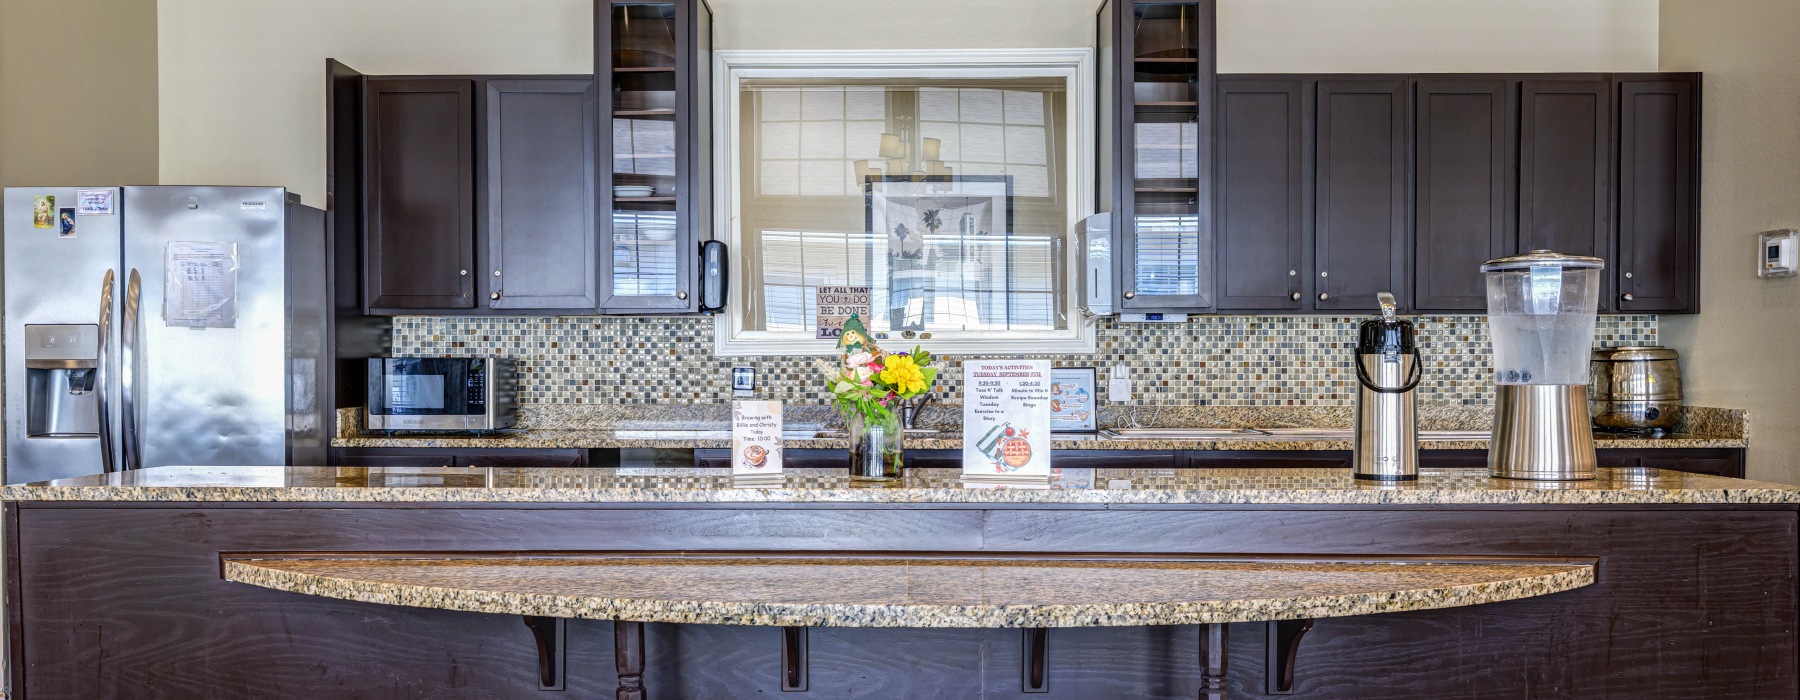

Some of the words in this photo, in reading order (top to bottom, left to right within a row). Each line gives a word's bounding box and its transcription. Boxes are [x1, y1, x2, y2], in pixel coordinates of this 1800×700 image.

[820, 295, 839, 303] YOU
[854, 295, 867, 303] DO
[820, 306, 834, 315] BE
[838, 306, 867, 315] DONE
